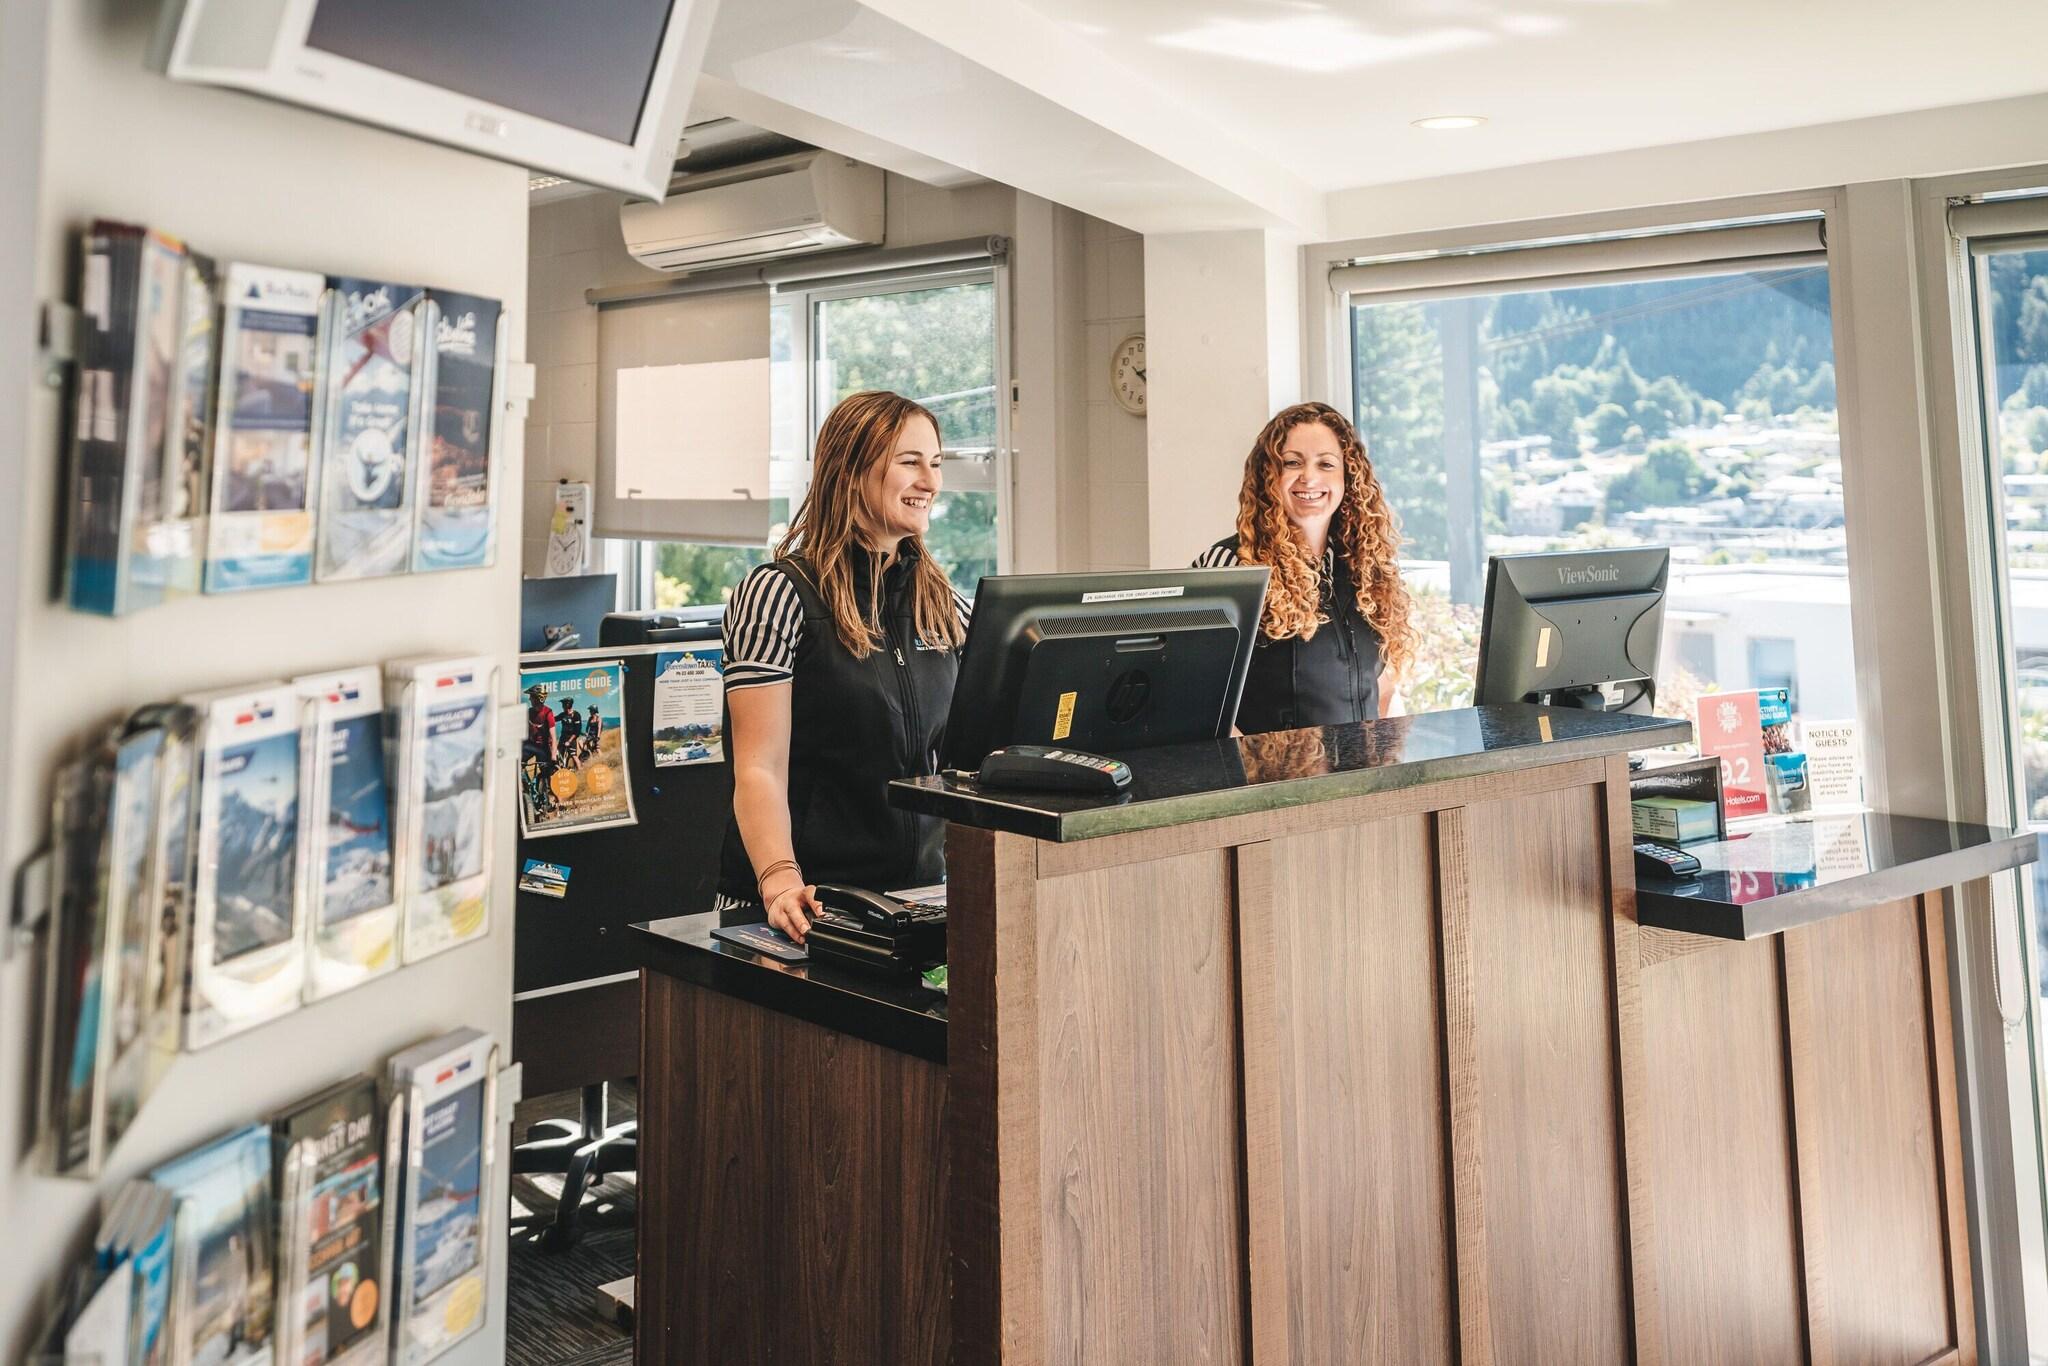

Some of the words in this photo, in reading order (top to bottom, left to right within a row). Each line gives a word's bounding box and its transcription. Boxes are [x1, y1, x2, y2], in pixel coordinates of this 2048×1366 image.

[1128, 347, 1134, 356] 11
[1137, 343, 1144, 352] 12
[1122, 357, 1129, 366] 10
[1118, 369, 1124, 378] 9
[1121, 383, 1127, 391] 8
[1129, 391, 1135, 400] 7
[1138, 395, 1144, 404] 6
[1558, 564, 1619, 584] ViewSonic
[540, 680, 559, 693] THE
[560, 678, 582, 692] RIDE
[584, 675, 613, 689] GUIDE
[1808, 729, 1838, 738] NOTICE
[1842, 729, 1853, 737] TO
[1815, 738, 1848, 747] GUESTS
[1720, 757, 1751, 787] 9.2
[1725, 794, 1760, 806] Hotels.com
